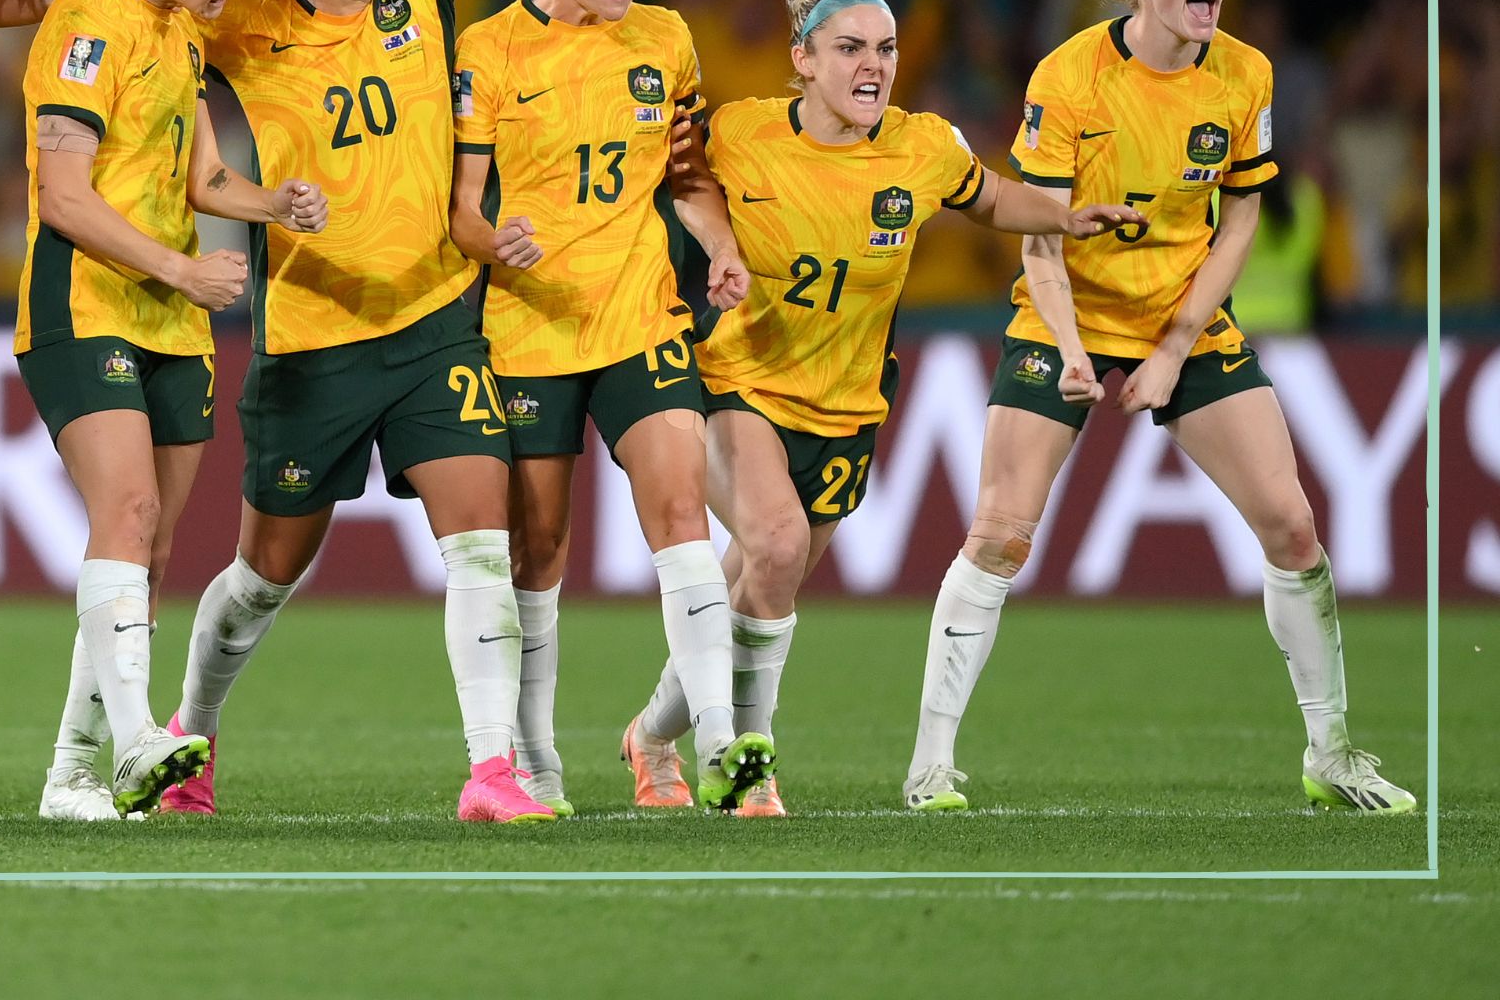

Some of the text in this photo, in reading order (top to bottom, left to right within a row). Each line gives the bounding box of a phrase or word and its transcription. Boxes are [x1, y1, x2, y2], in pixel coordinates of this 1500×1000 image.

[323, 75, 398, 150] 20
[574, 141, 627, 204] 13
[1115, 191, 1157, 243] 5
[783, 254, 850, 313] 21
[447, 365, 507, 425] 20
[303, 328, 1500, 595] AWAY
[811, 453, 870, 514] 21
